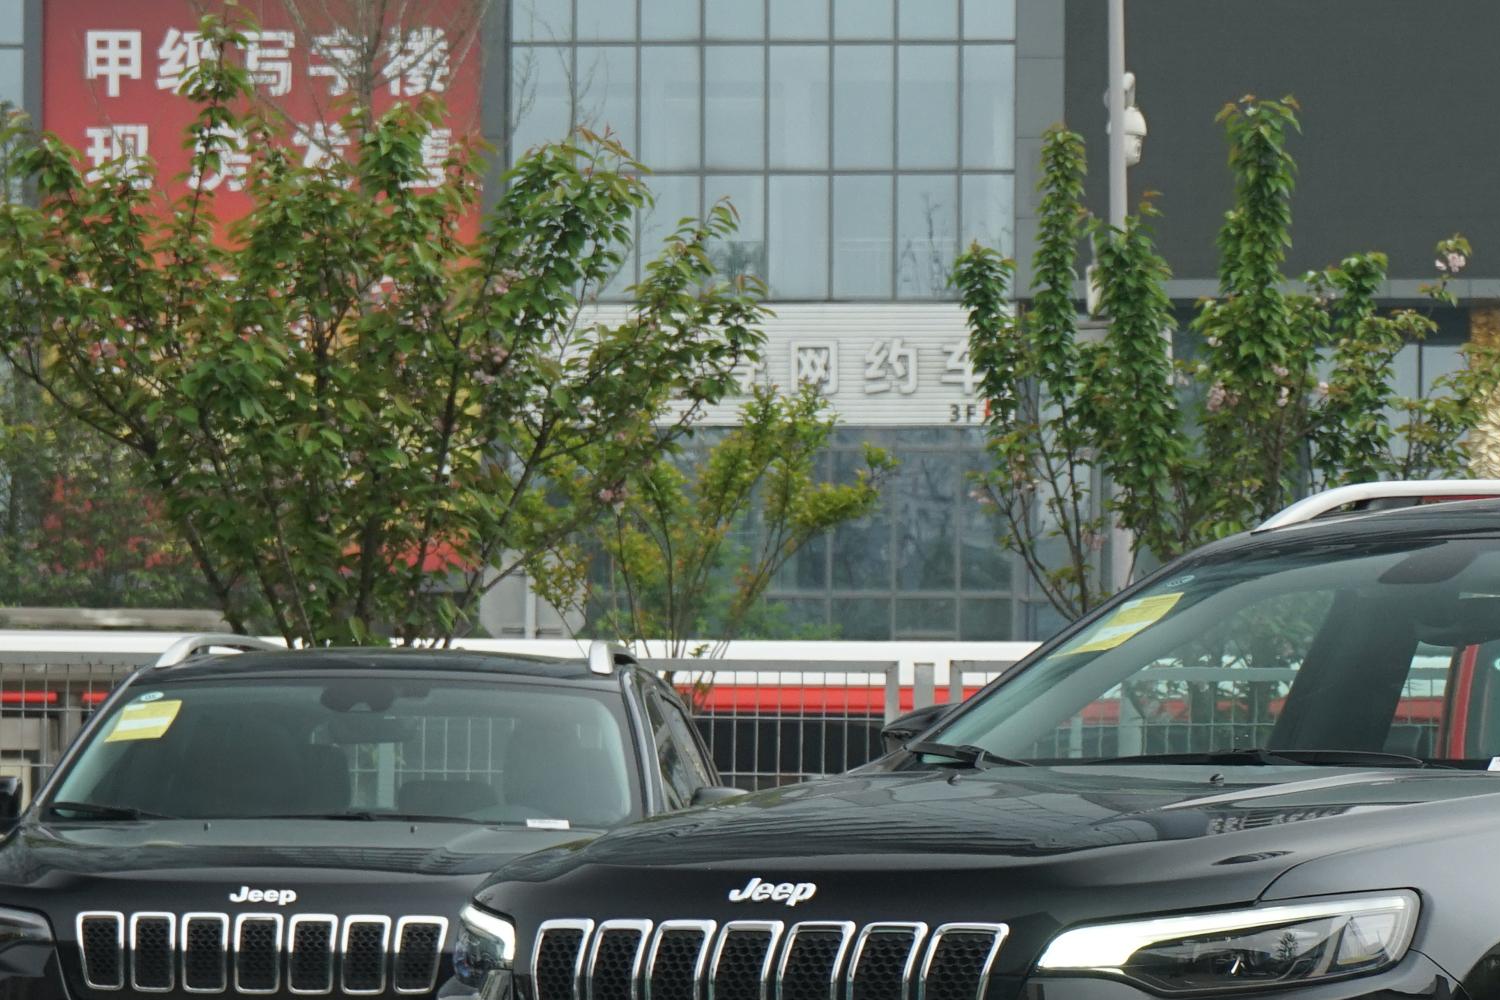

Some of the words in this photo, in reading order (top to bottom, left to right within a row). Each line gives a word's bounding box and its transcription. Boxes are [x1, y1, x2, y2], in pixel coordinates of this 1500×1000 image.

[85, 26, 450, 98] 甲级写字楼
[949, 403, 977, 422] 3F
[229, 885, 297, 906] Jeep
[728, 877, 817, 906] Jeep
